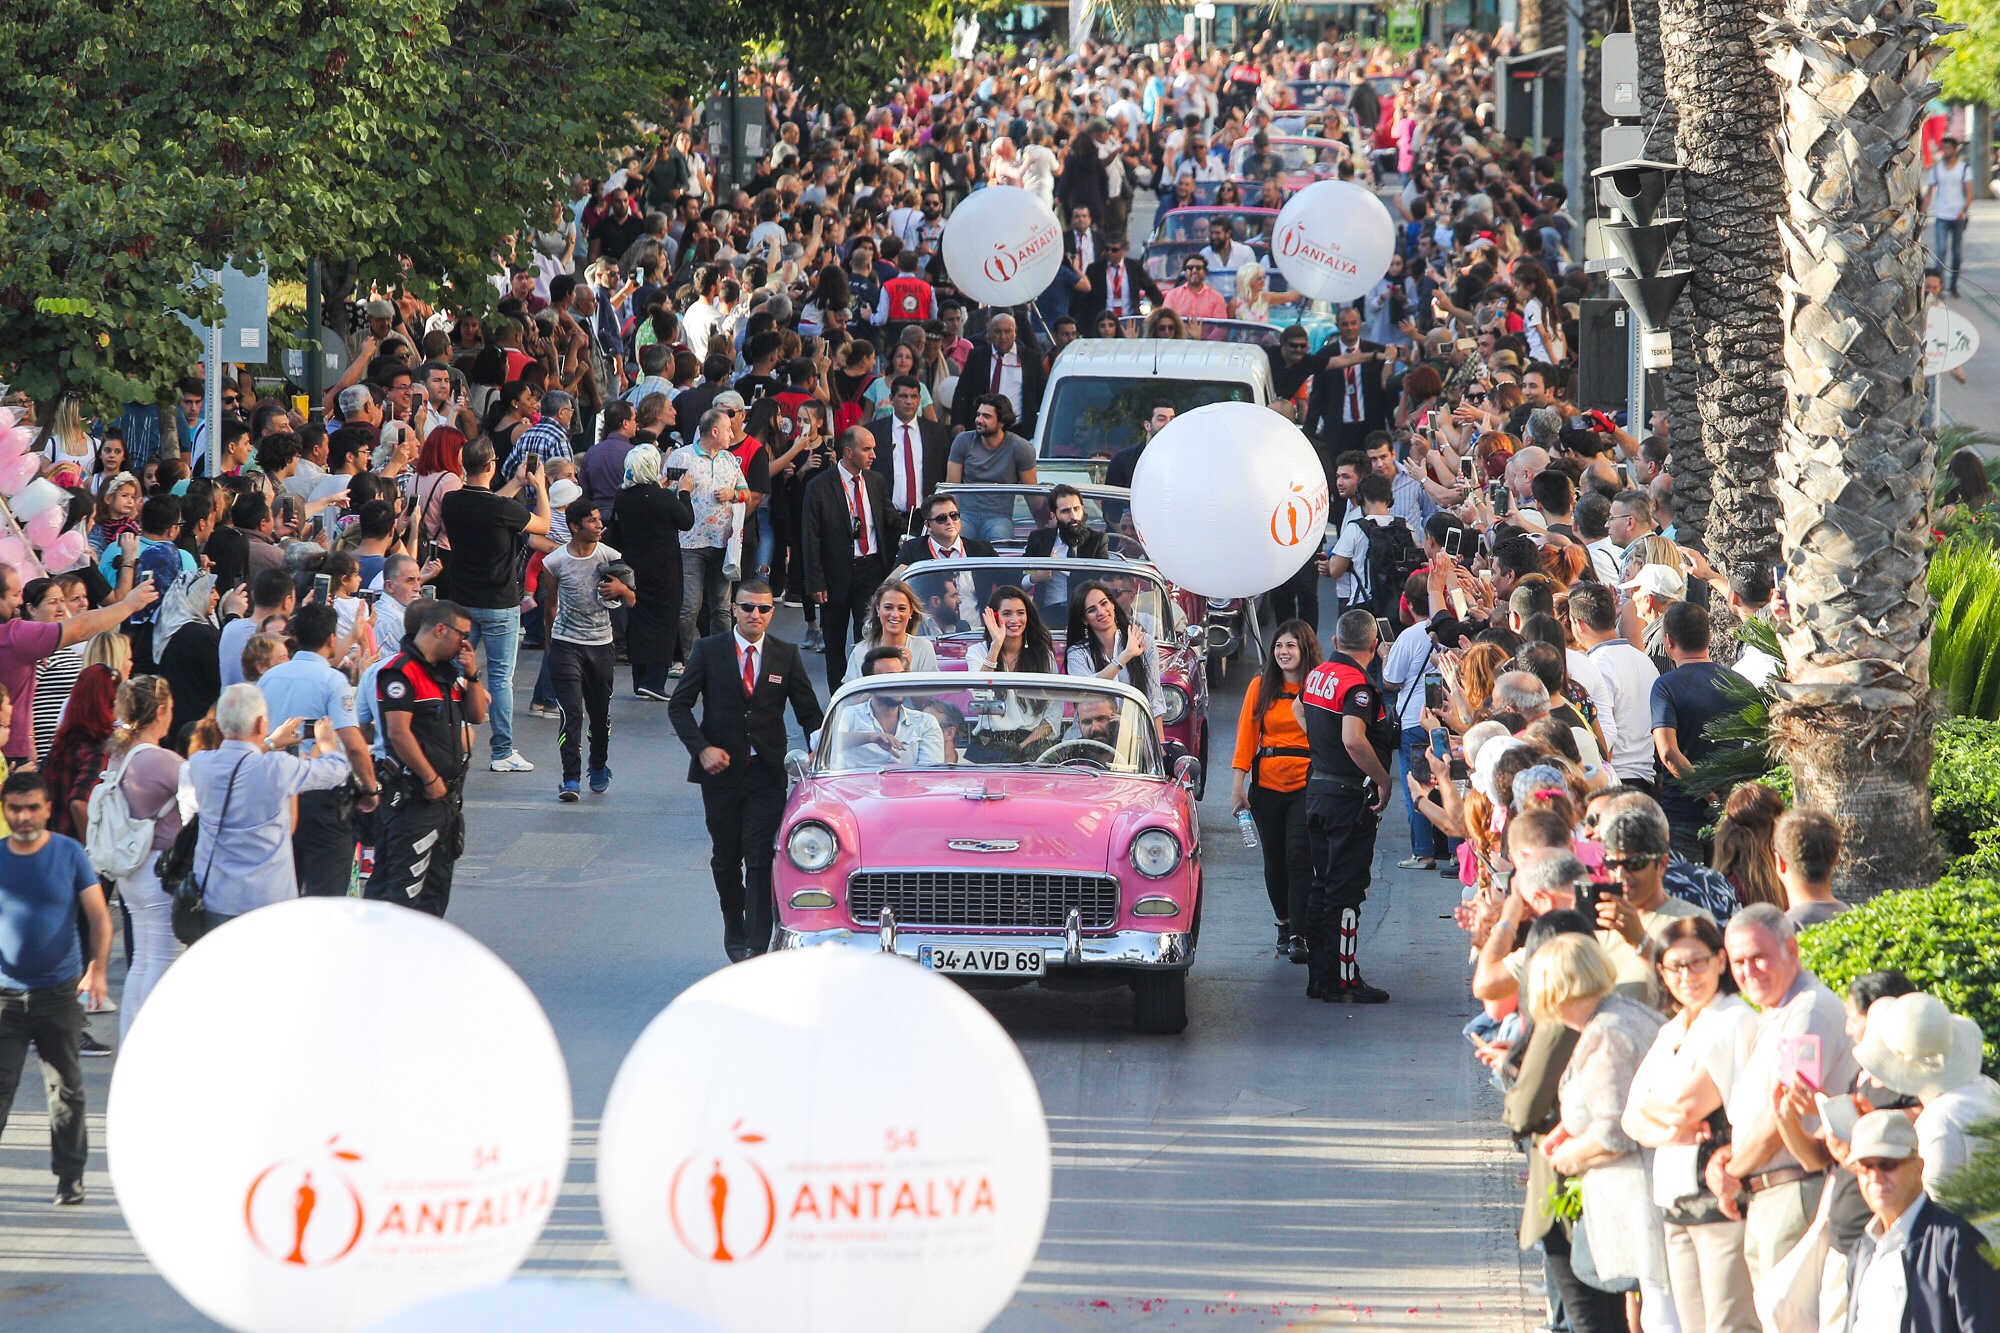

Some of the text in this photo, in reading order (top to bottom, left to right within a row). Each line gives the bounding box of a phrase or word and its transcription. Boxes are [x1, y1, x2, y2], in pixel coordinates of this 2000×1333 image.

[1018, 225, 1059, 262] ANTALYA
[1300, 244, 1357, 275] ANTALYA
[933, 950, 1040, 971] 34 AVD 69
[885, 1127, 918, 1151] 54
[376, 1177, 550, 1236] ANTALYA
[789, 1176, 996, 1220] ANTALYA
